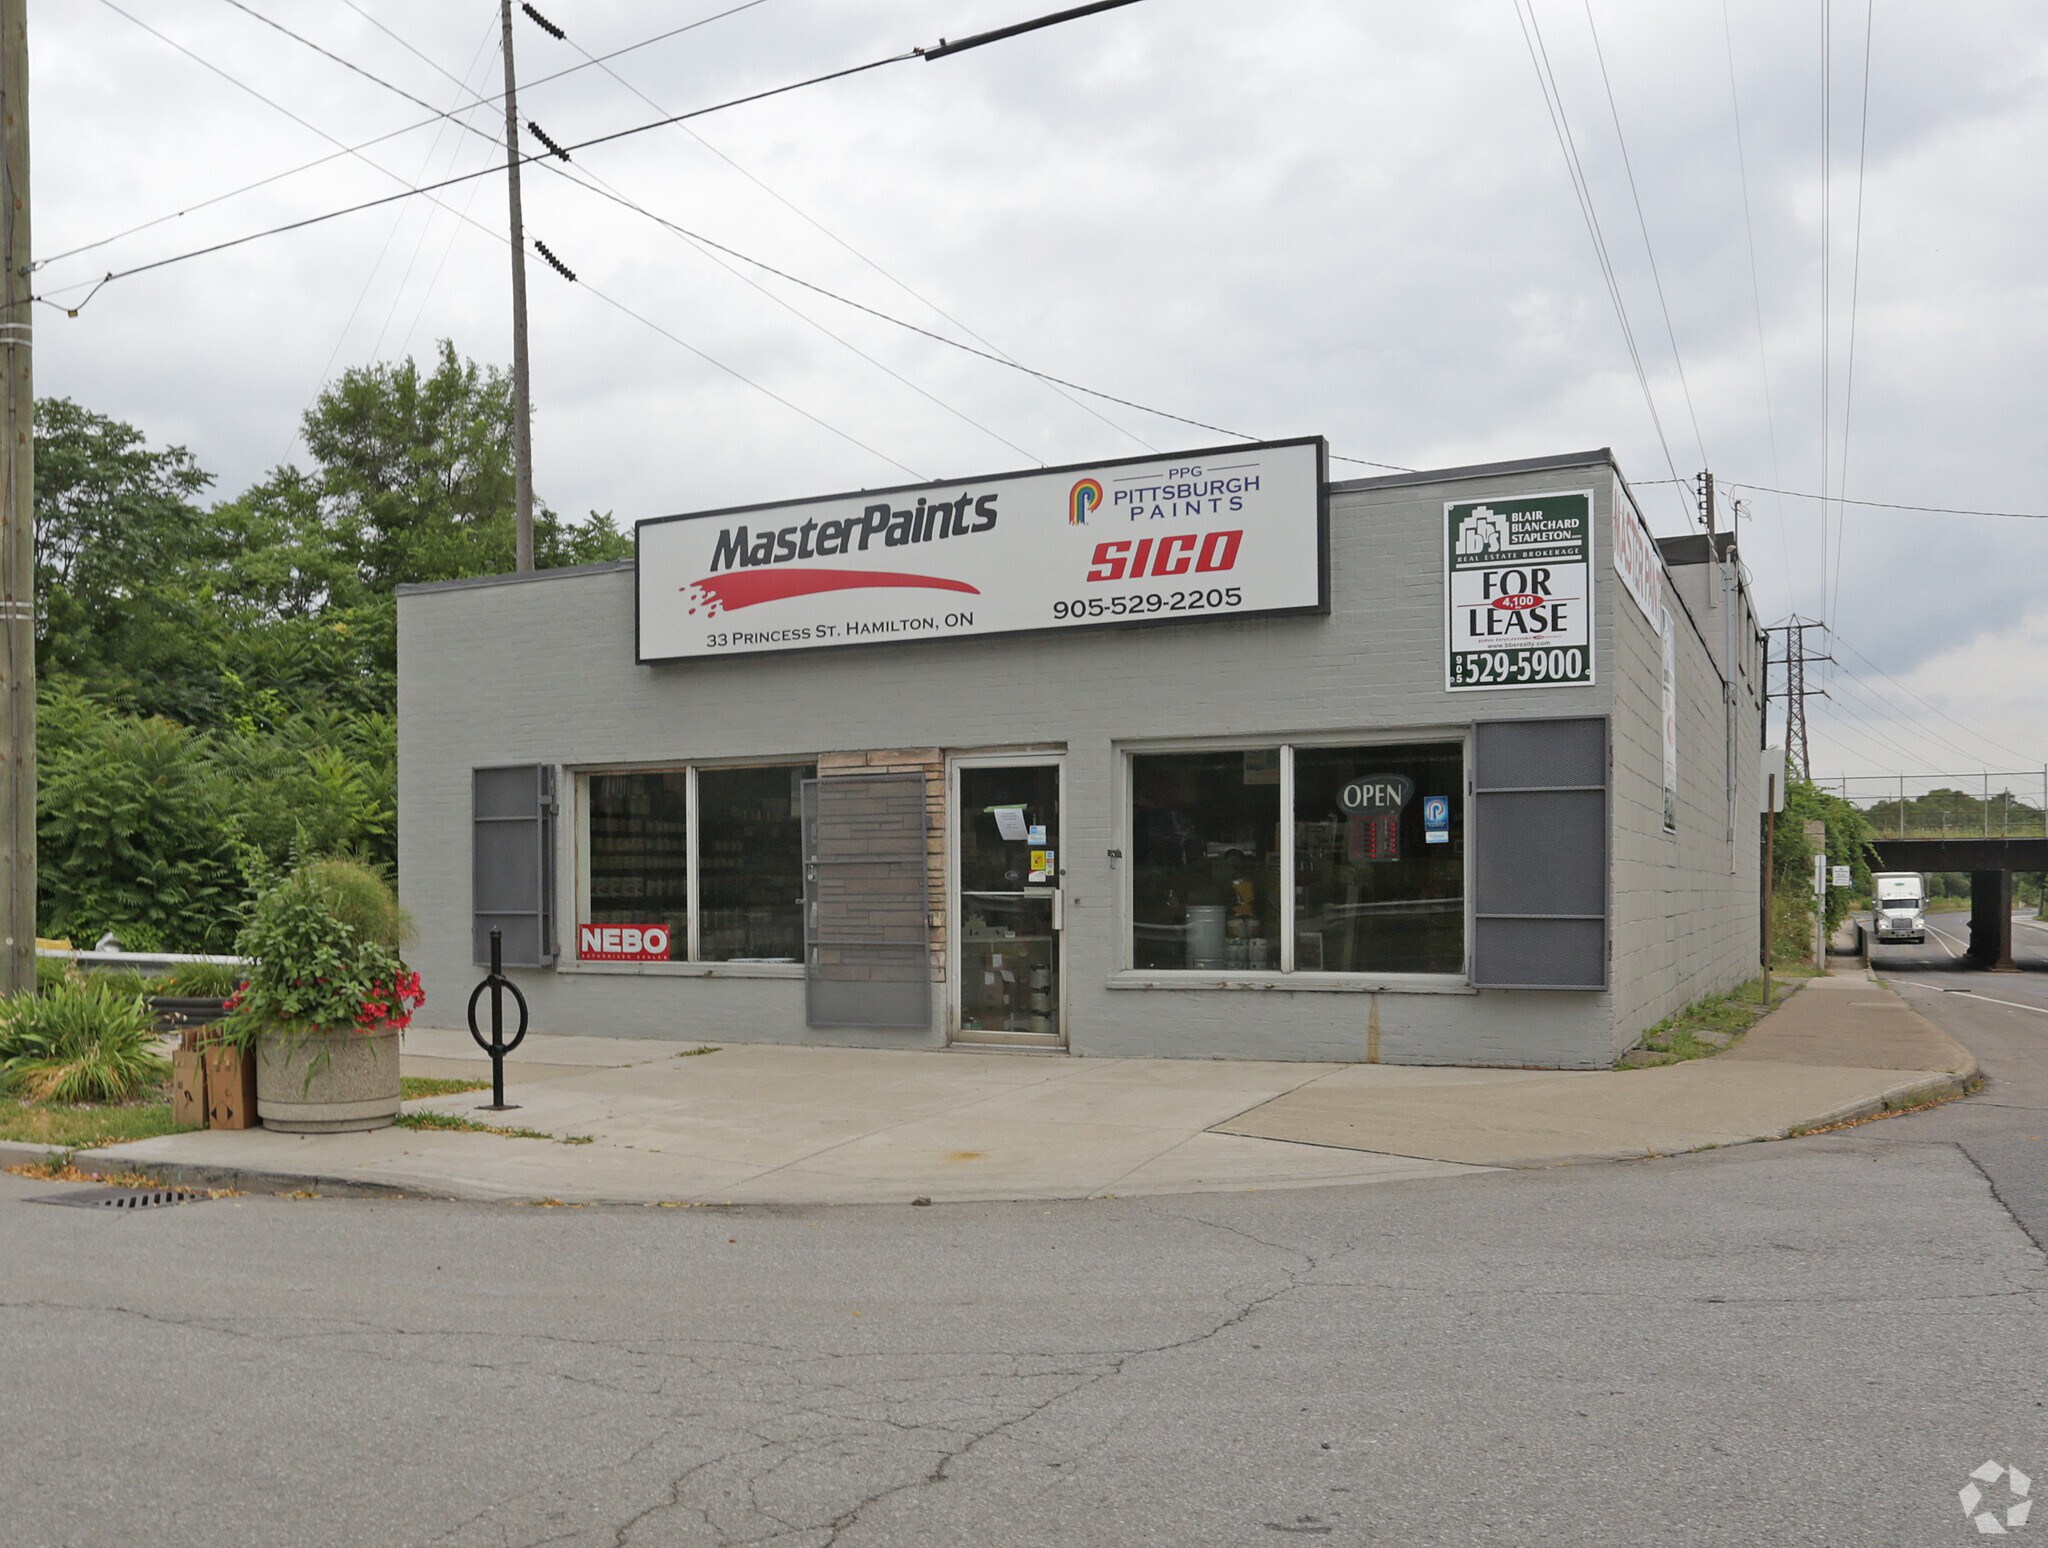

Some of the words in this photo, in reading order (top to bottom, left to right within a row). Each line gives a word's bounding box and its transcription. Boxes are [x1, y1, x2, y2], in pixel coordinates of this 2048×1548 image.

[1168, 466, 1203, 480] PPG
[1113, 475, 1261, 506] PITTSBURGH
[1129, 496, 1244, 522] PAINTS
[1511, 510, 1544, 522] BLAIR
[709, 491, 999, 572] MasterPaints
[1511, 518, 1580, 533] BLANCHARD
[1511, 530, 1572, 544] STAPLETON
[1085, 529, 1245, 583] SICO
[1457, 555, 1480, 563] REAL
[1484, 552, 1518, 561] ESTATE
[1522, 547, 1580, 558] BROKERAGE
[1483, 567, 1552, 600] FOR
[1052, 586, 1243, 620] 905-529-2205
[1502, 595, 1535, 608] 4,100
[706, 633, 729, 648] 33
[943, 611, 975, 628] ON
[1469, 603, 1568, 637] LEASE
[1465, 648, 1583, 684] 529-5900
[1343, 783, 1402, 808] OPEN
[581, 927, 668, 955] NEBO
